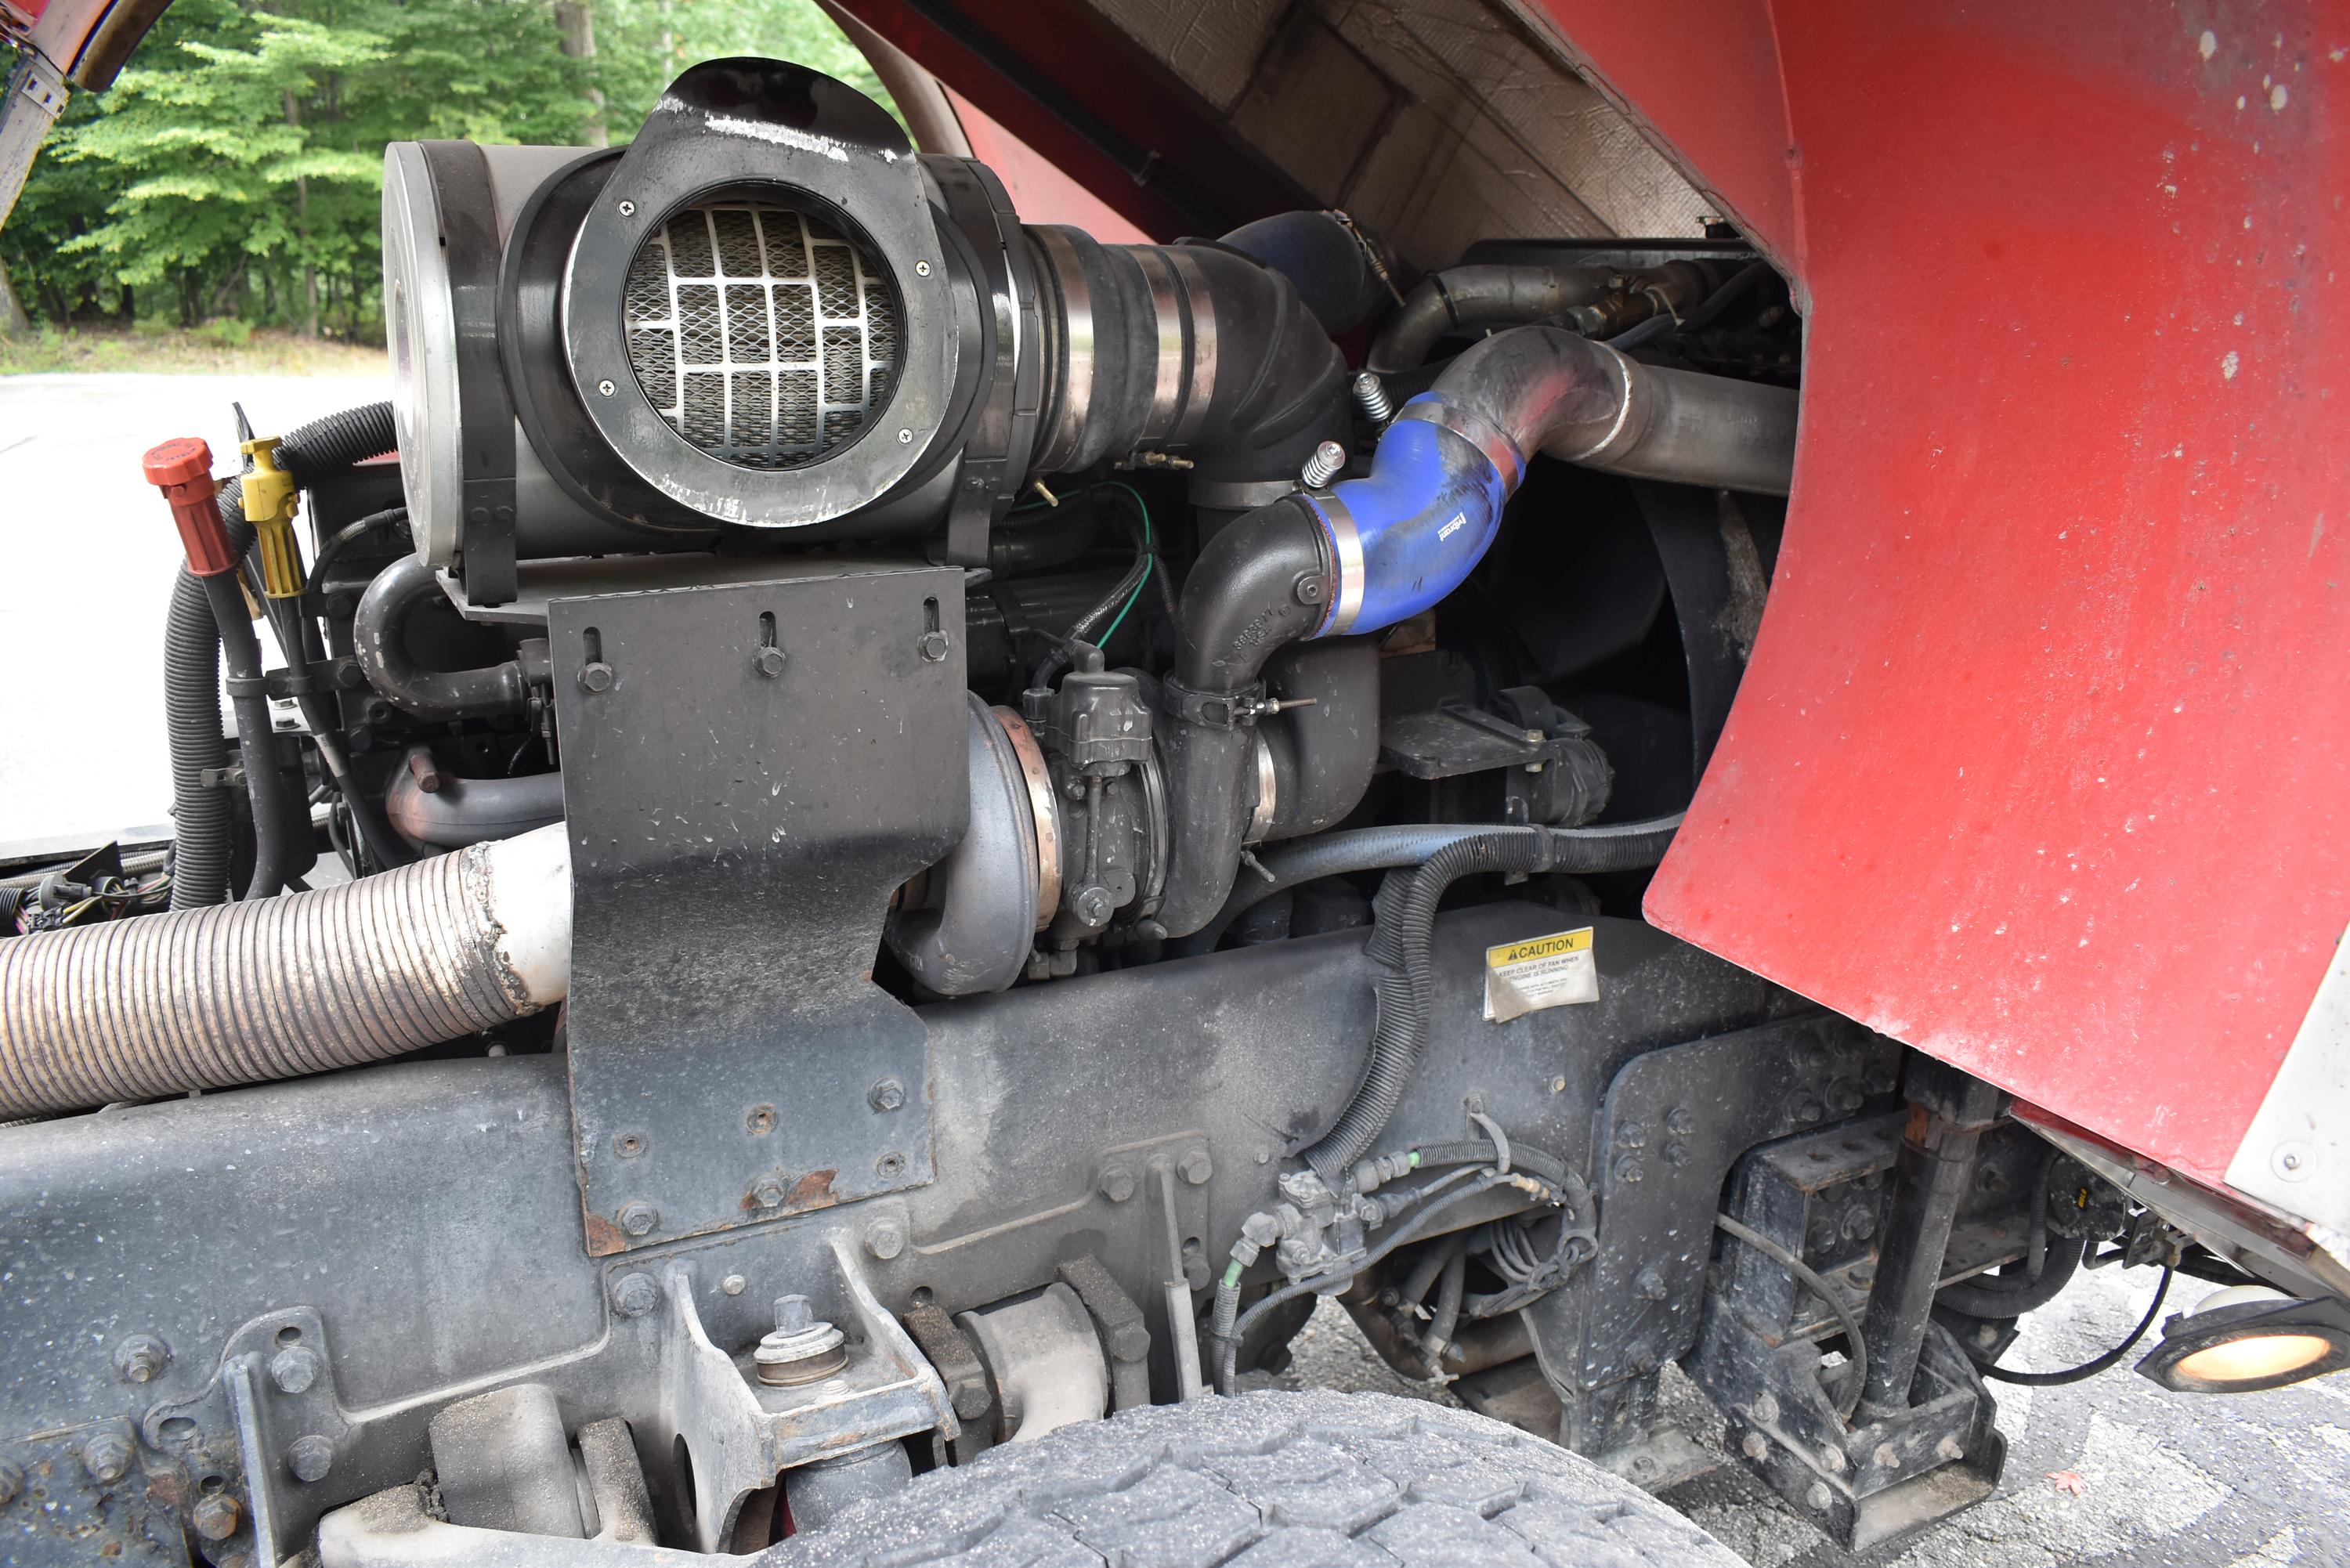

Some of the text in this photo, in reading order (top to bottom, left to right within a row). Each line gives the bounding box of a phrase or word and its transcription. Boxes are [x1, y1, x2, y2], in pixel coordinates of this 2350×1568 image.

[1519, 938, 1574, 959] CAUTION
[1499, 969, 1516, 977] KEEP
[1516, 964, 1537, 974] CLEAR
[1540, 966, 1567, 975] RUNNING
